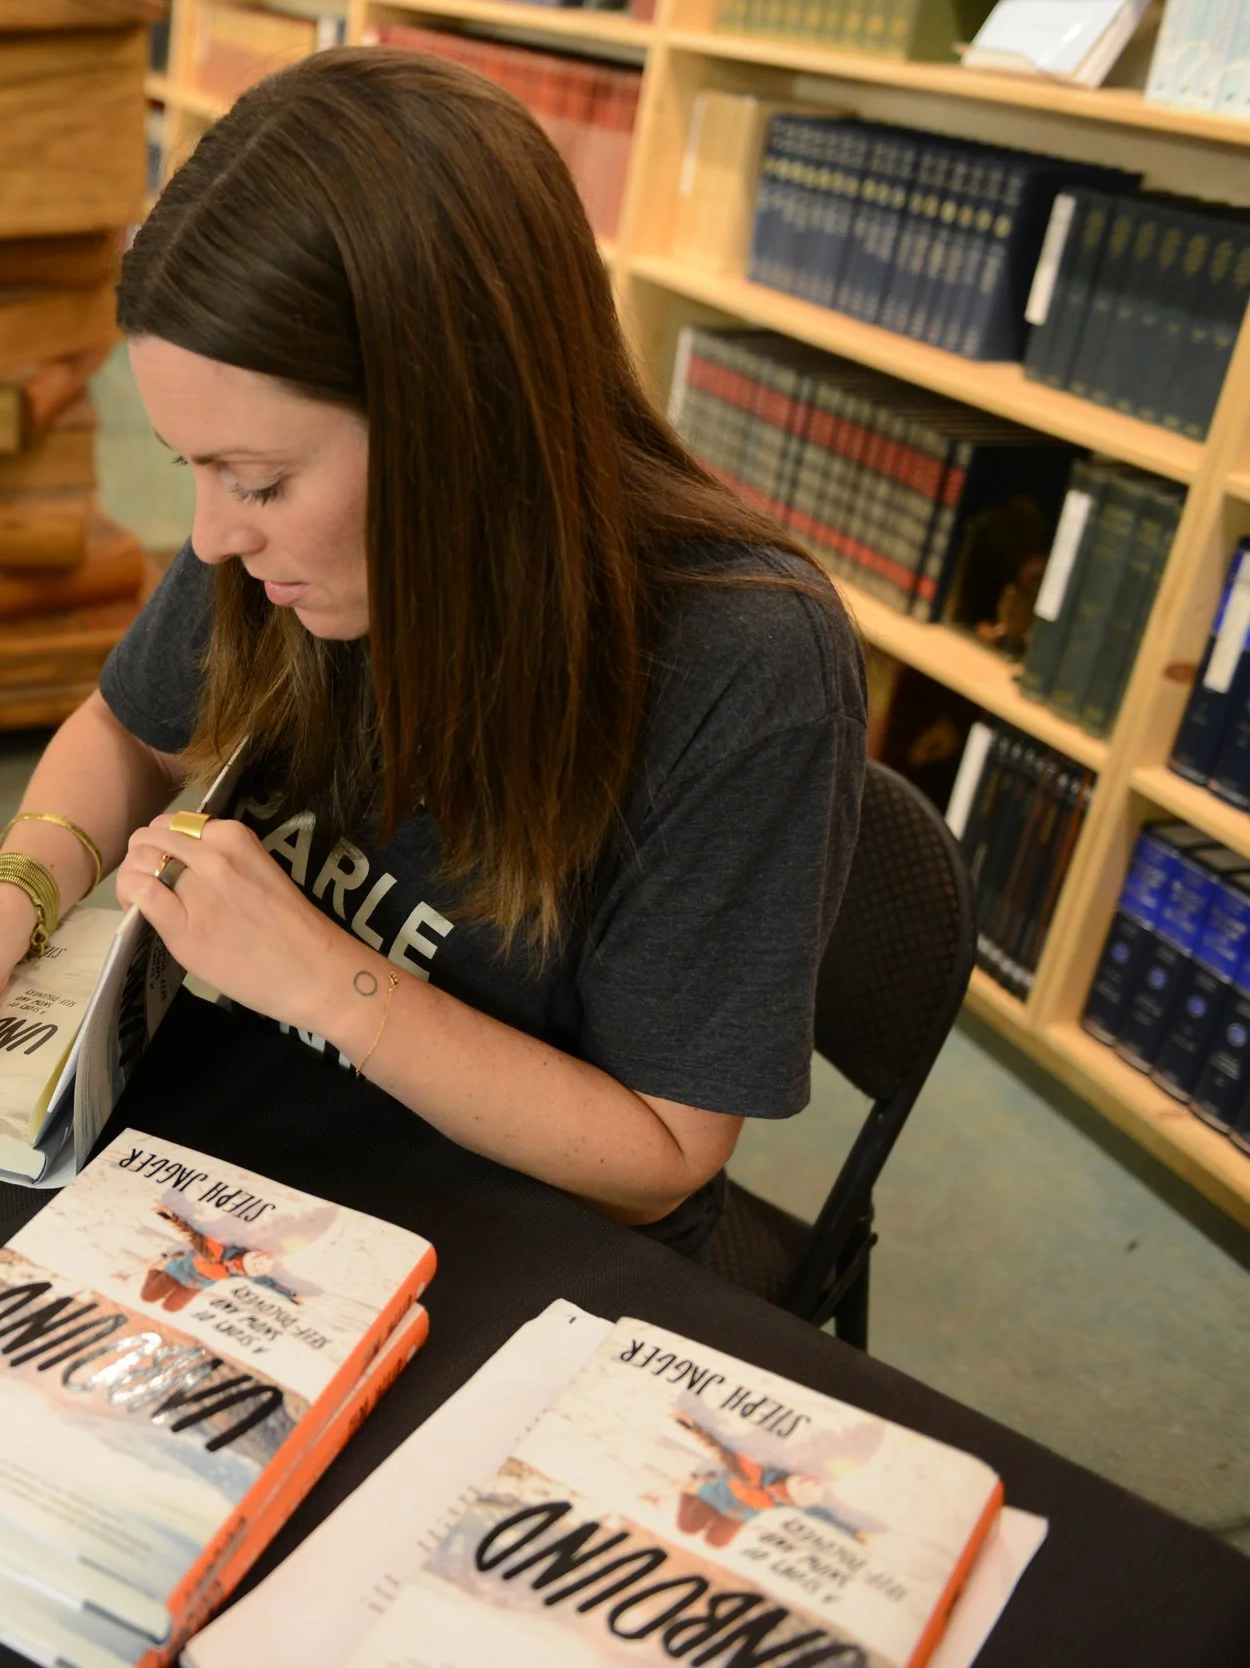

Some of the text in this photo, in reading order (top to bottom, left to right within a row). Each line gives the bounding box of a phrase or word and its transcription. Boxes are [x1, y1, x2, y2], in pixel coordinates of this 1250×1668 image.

[32, 999, 53, 1009] SNOW
[119, 1149, 276, 1223] STEPH JAGGER
[191, 1310, 214, 1322] OF
[209, 1299, 283, 1341] SNOW AND
[215, 1321, 258, 1347] STORY
[231, 1285, 332, 1350] SELF-DISCOVERY
[619, 1339, 812, 1440] STEPH JAGGER
[474, 1500, 867, 1668] NBOUND
